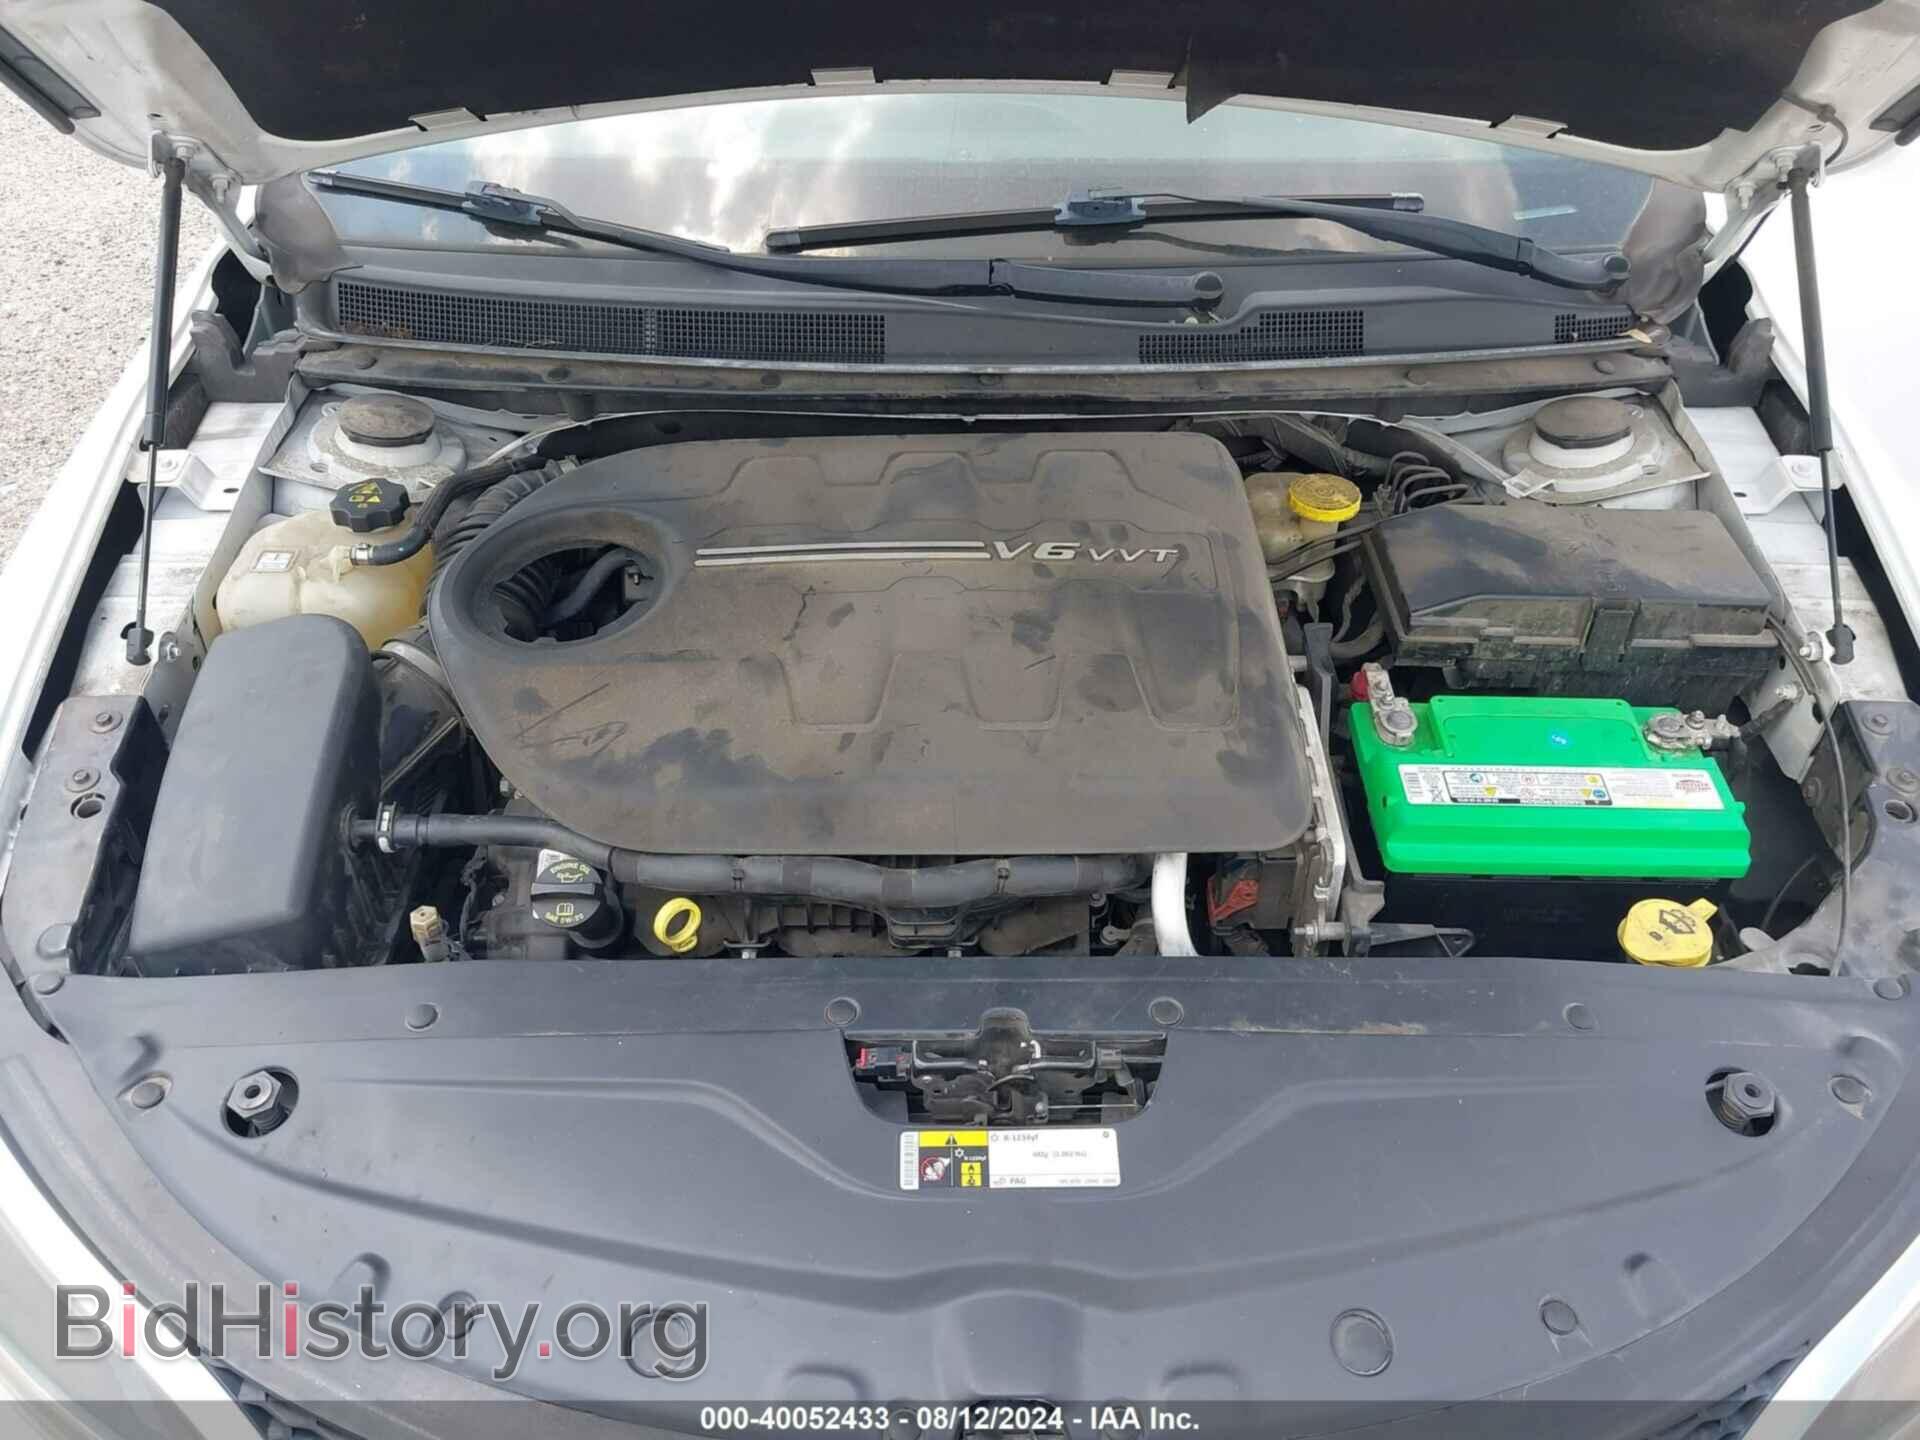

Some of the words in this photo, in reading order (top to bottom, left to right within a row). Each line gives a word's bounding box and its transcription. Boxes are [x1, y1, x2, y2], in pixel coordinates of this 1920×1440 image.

[993, 541, 1081, 560] V6
[1089, 548, 1178, 562] VVT
[1010, 1177, 1026, 1185] PAG
